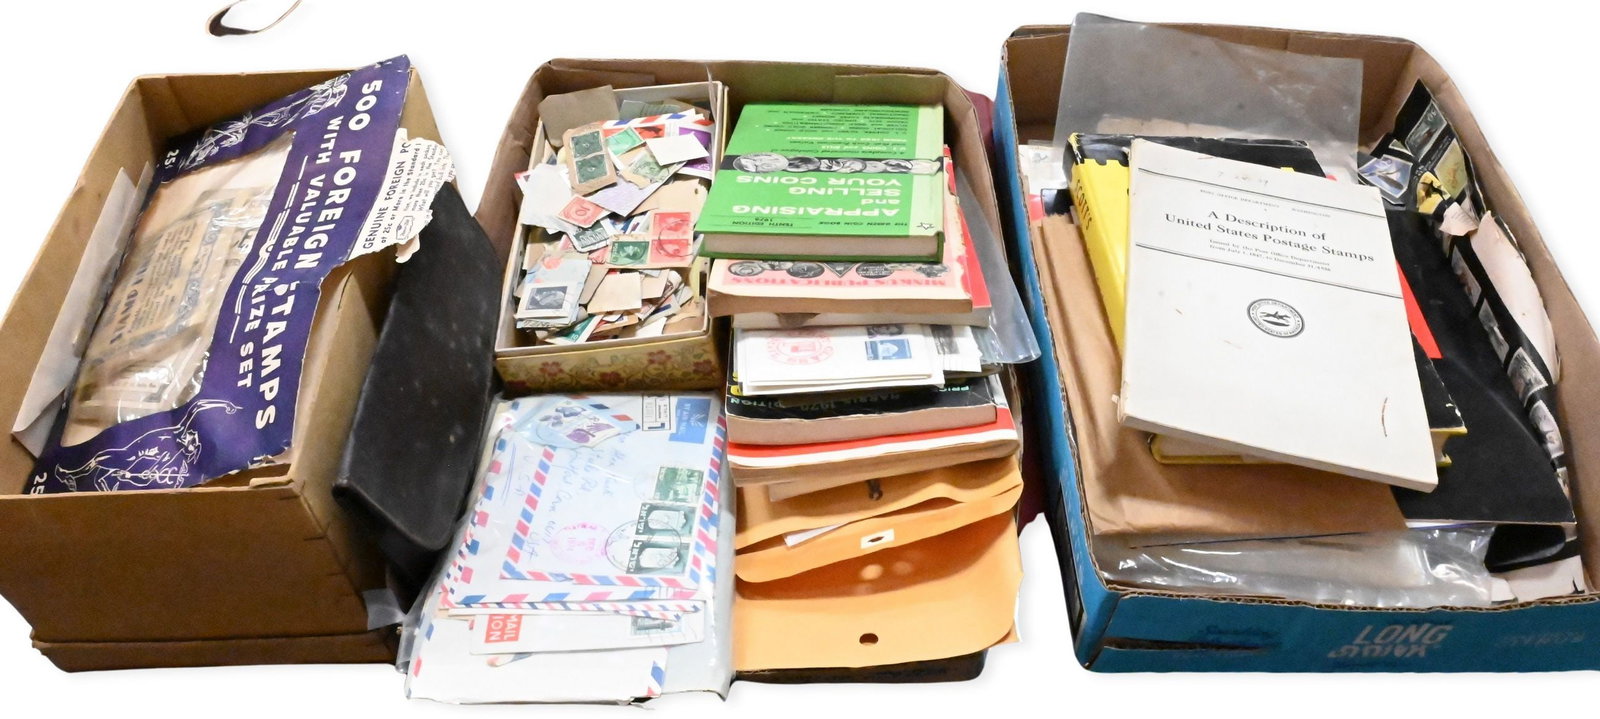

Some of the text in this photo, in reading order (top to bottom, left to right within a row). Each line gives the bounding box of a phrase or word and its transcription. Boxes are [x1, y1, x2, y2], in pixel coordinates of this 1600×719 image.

[348, 79, 383, 131] 500
[164, 149, 180, 169] 25
[315, 115, 345, 165] WITH
[736, 175, 903, 186] YOUR COINS
[788, 187, 901, 196] SELLING
[271, 173, 326, 272] VALUABLE
[293, 149, 362, 269] FOREIGN
[363, 206, 389, 249] GENUINE
[384, 160, 406, 202] FOREIGN
[732, 205, 900, 217] APPRAISING
[1076, 178, 1092, 231] SCOTT'S
[1164, 212, 1375, 263] United States Postage Stamps
[1207, 210, 1327, 241] A Description of
[731, 277, 869, 287] PUBLICATIONS
[237, 341, 255, 389] SET
[730, 397, 785, 409] DITION
[1353, 623, 1455, 645] LONG
